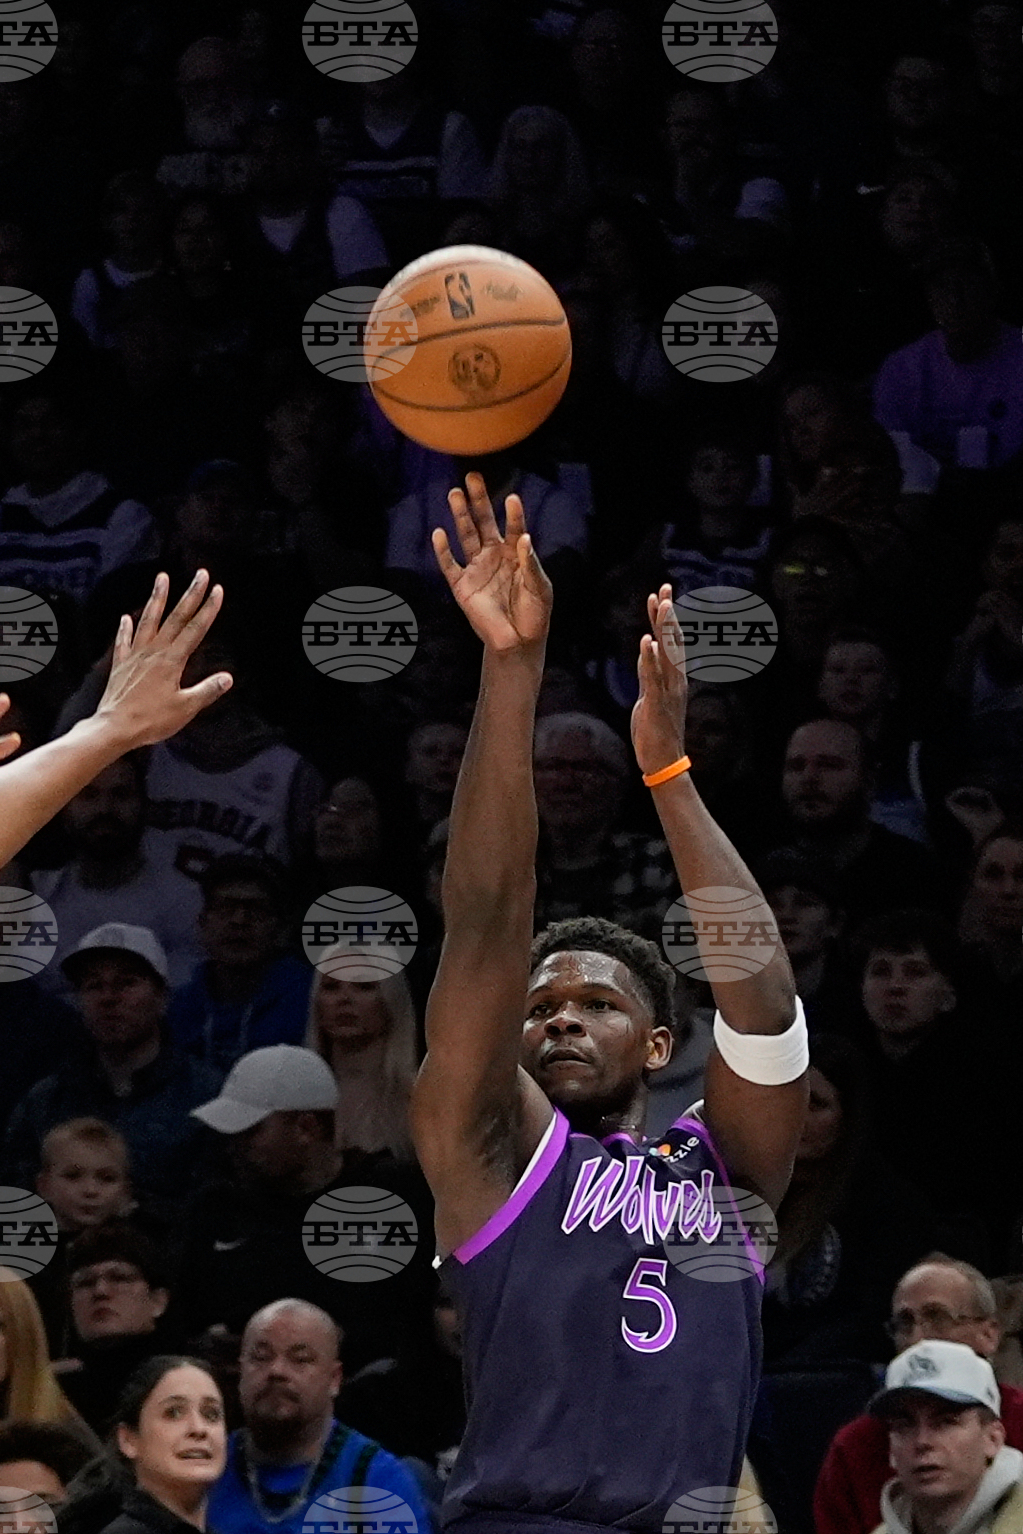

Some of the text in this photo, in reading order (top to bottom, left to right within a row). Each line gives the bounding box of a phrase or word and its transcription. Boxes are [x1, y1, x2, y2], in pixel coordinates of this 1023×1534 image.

[662, 1136, 700, 1163] zzle
[561, 1155, 722, 1245] Wolves
[621, 1257, 677, 1353] 5
